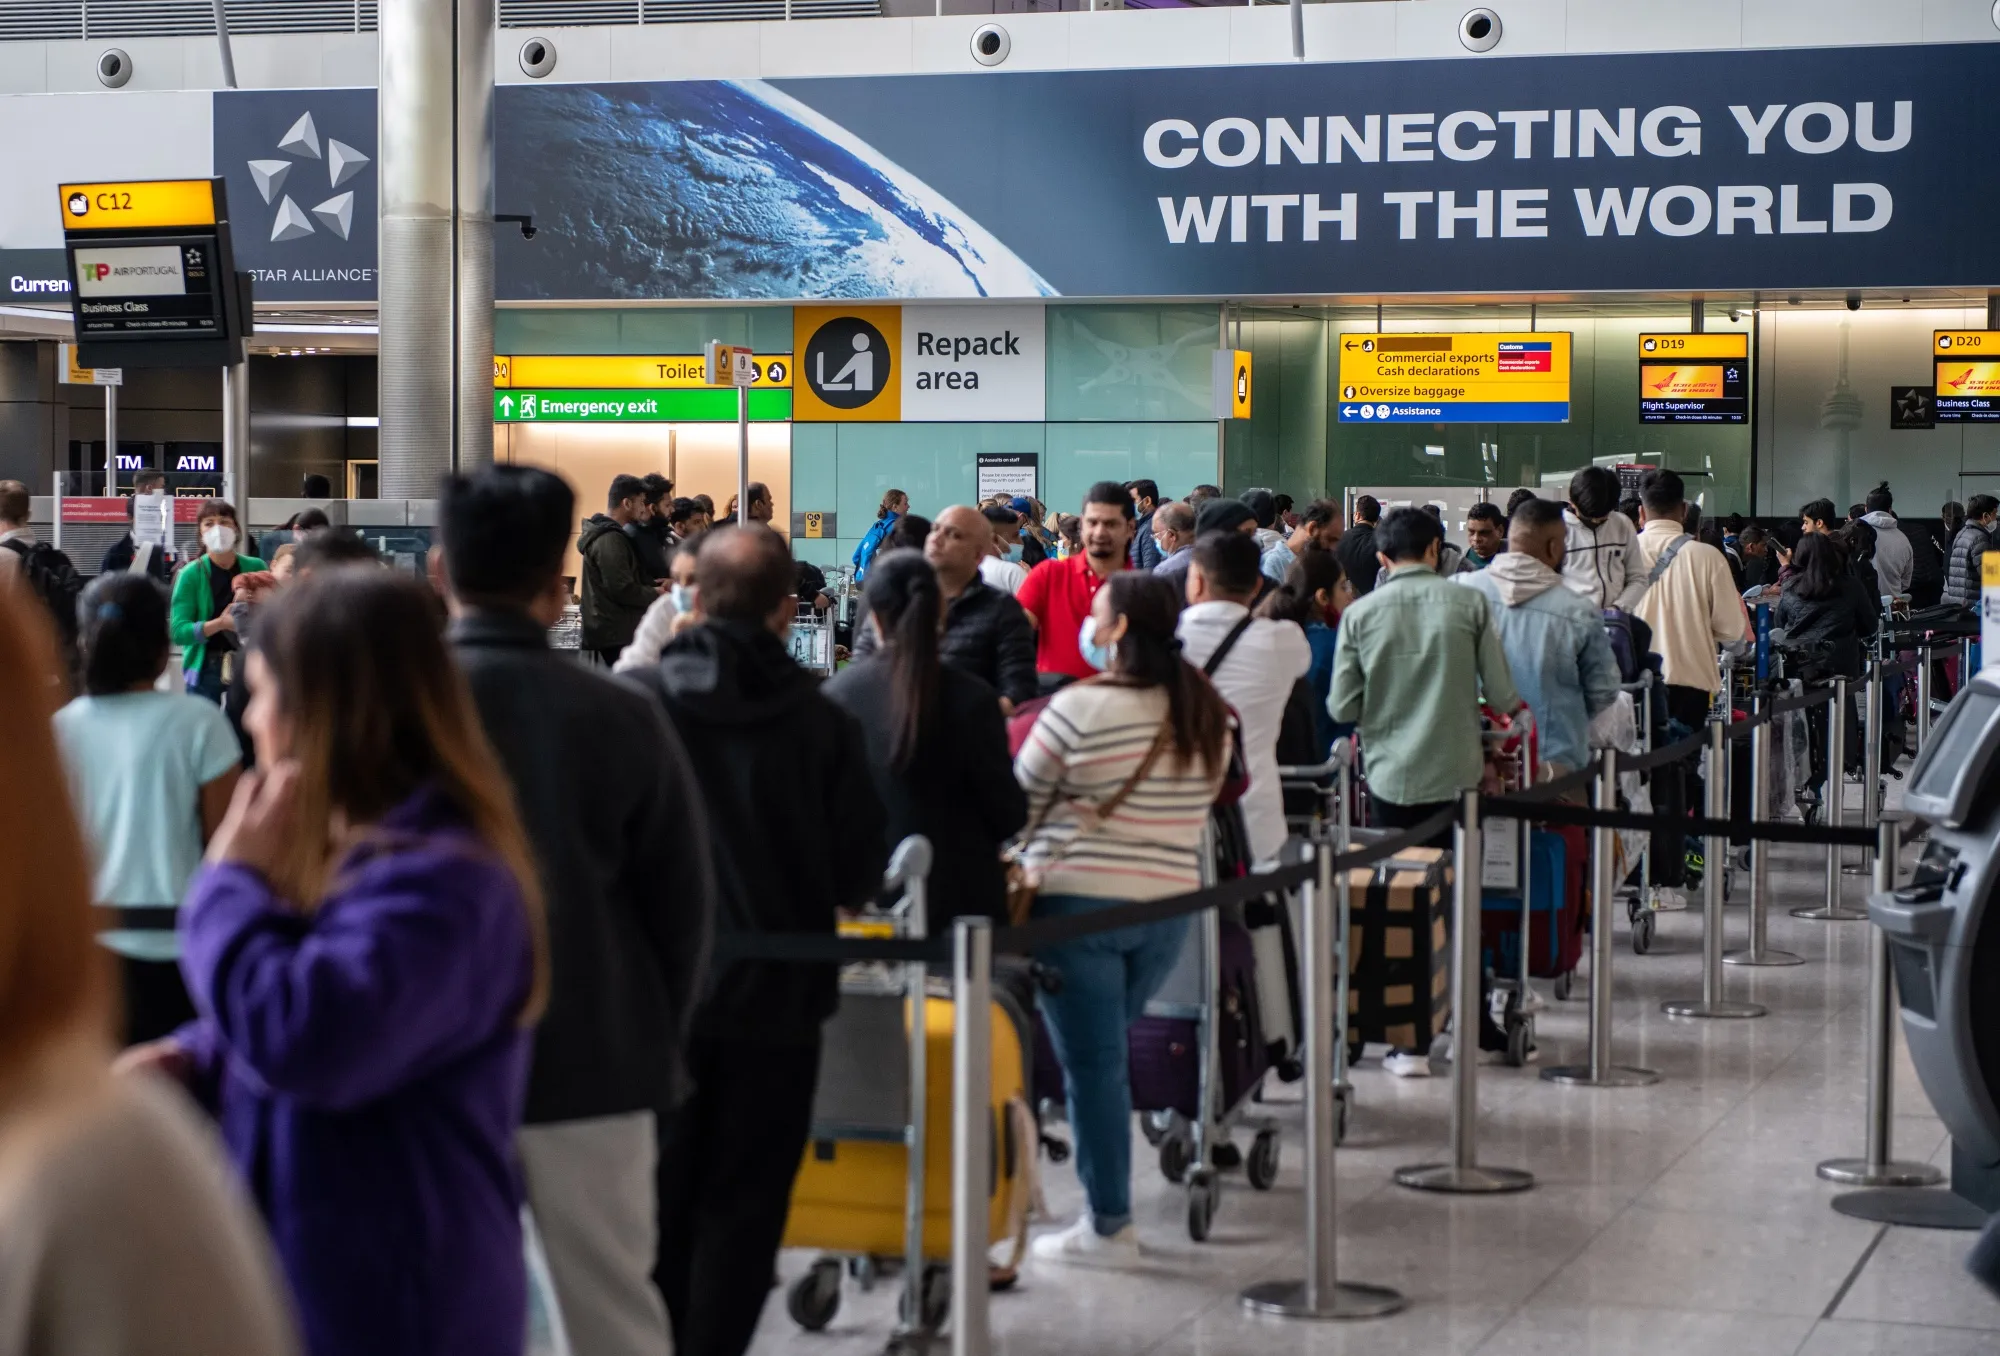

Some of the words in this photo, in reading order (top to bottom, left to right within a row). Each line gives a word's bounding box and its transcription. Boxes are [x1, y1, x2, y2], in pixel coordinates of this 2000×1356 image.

[1143, 105, 1702, 169] CONNECTING
[1728, 100, 1913, 155] YOU
[96, 193, 133, 211] C12
[1157, 192, 1358, 244] WITH
[1383, 188, 1549, 240] THE
[1573, 182, 1894, 237] WORLD
[247, 269, 287, 281] STAR
[81, 302, 122, 313] Business
[123, 301, 149, 312] Class
[917, 330, 1021, 362] Repack
[1661, 339, 1685, 349] D19
[1956, 336, 1981, 346] D20
[1377, 353, 1447, 363] Commercial
[1449, 353, 1494, 365] exports
[1377, 365, 1405, 376] Cash
[1407, 365, 1480, 376] declarations
[916, 371, 979, 390] area
[1359, 386, 1410, 396] Oversize
[1414, 386, 1465, 399] baggage
[541, 400, 624, 417] Emergency
[628, 399, 657, 414] exit
[1642, 402, 1664, 411] Flight
[1665, 402, 1705, 411] Supervisor
[1971, 399, 1990, 407] Class
[1392, 407, 1441, 416] Assistance
[104, 455, 142, 469] TM
[177, 456, 215, 470] ATM
